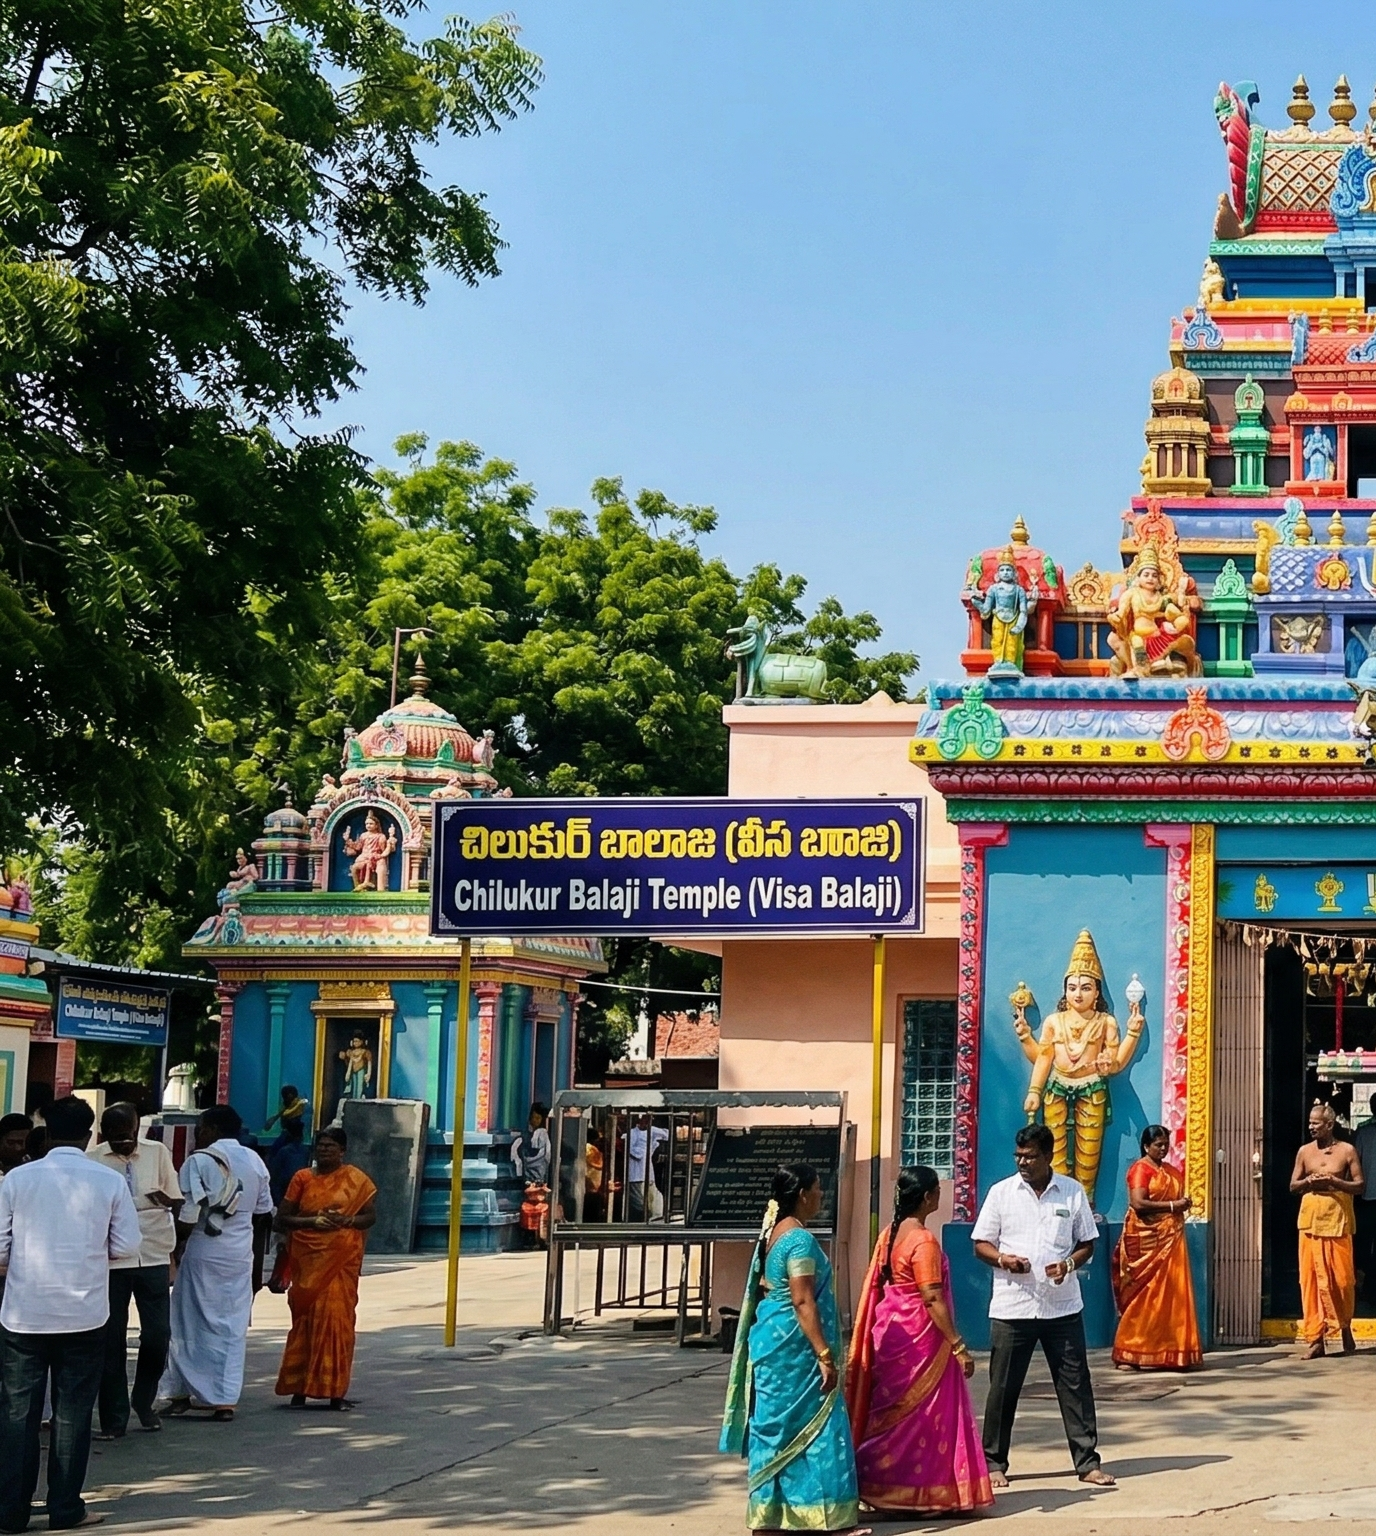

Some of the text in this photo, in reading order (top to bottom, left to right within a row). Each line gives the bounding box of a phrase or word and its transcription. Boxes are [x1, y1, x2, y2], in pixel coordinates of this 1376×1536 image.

[454, 875, 902, 918] Chilukur Balaji Temple (Visa Balaji)
